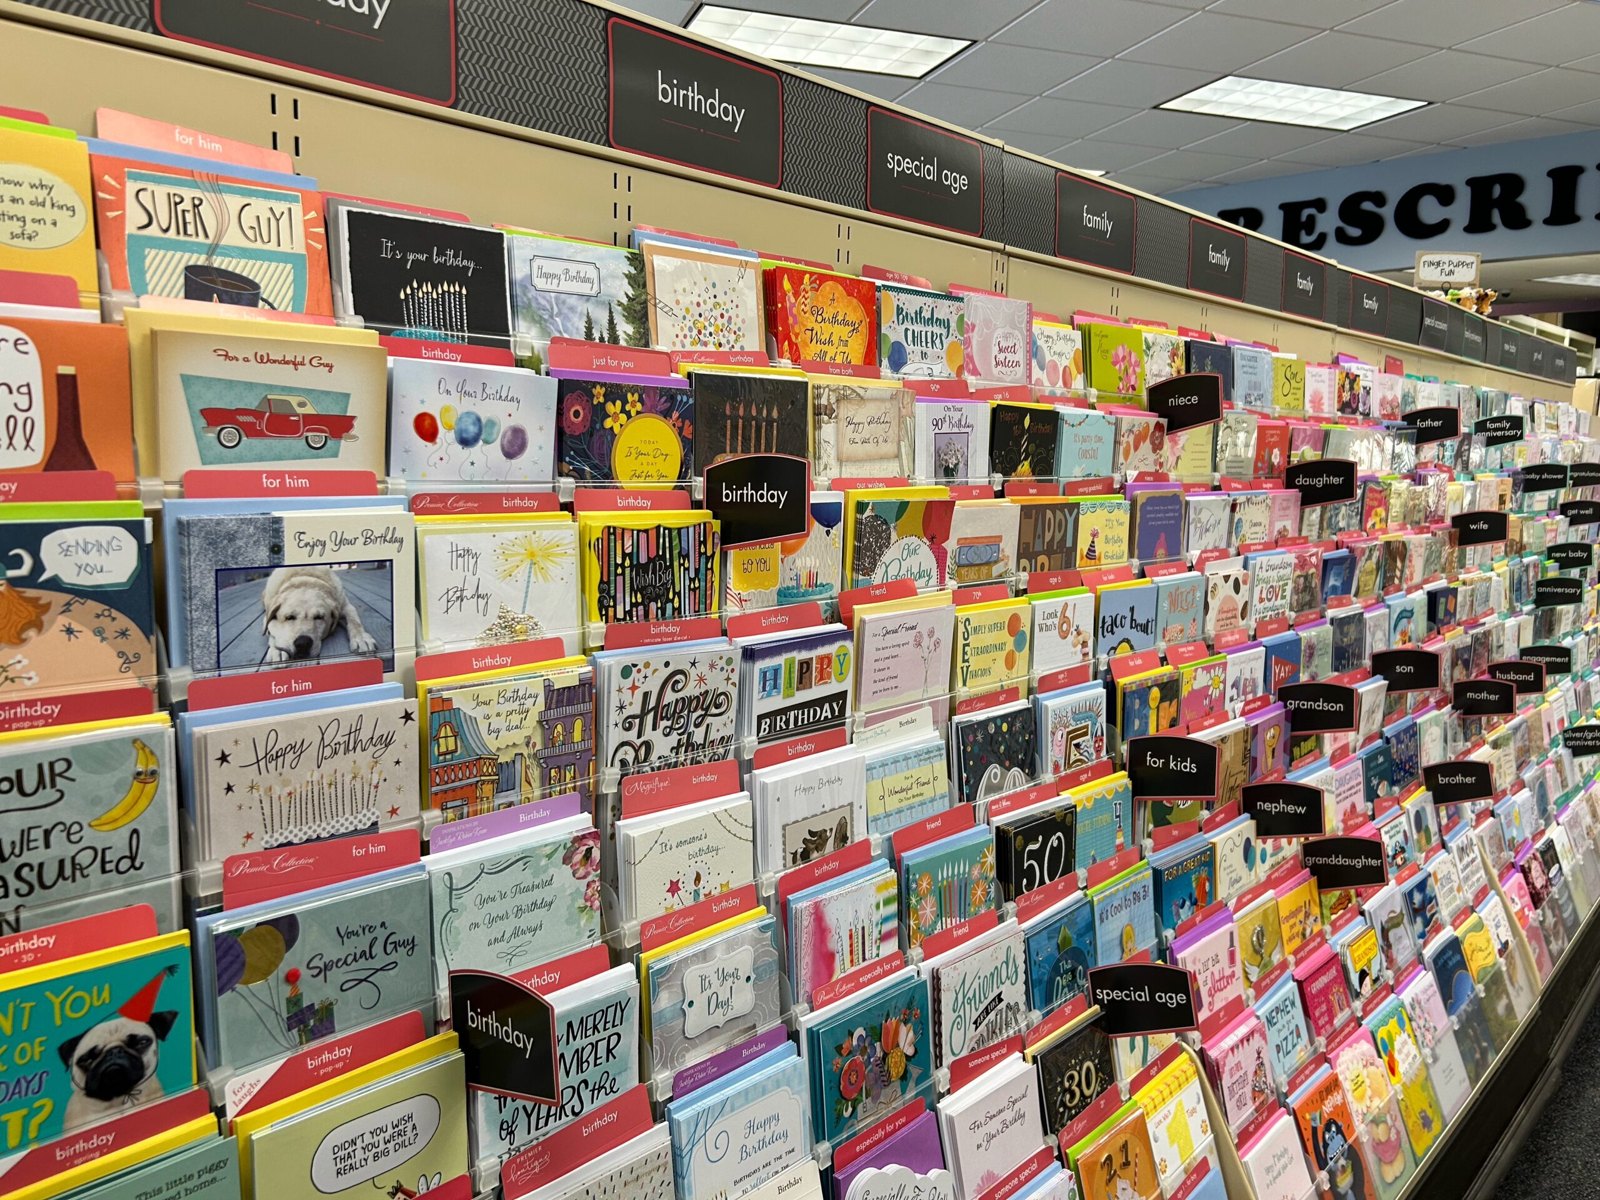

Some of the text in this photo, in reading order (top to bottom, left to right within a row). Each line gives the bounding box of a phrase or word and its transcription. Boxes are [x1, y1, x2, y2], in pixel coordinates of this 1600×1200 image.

[658, 70, 745, 133] birthday
[174, 126, 223, 153] for him
[886, 151, 969, 194] special age
[28, 177, 55, 197] why
[8, 195, 76, 219] an old king
[1217, 162, 1600, 251] ESCRI
[30, 217, 47, 226] on
[135, 187, 296, 250] SUPER GUY!
[1083, 204, 1114, 239] family
[9, 229, 39, 242] sofa?
[379, 238, 430, 269] It's your
[1208, 244, 1231, 272] family
[535, 264, 595, 292] Happy Birthday
[1296, 271, 1314, 297] family
[827, 292, 837, 307] A
[1363, 292, 1379, 315] family
[810, 305, 864, 339] Birthday
[895, 303, 951, 340] Birthday
[804, 325, 849, 350] Wish from
[903, 327, 945, 351] CHEERS
[996, 341, 1019, 356] Sweet
[212, 347, 335, 374] For a Wonderful Guy
[421, 346, 463, 364] birthday
[591, 355, 635, 370] just for you
[812, 349, 841, 365] All of
[919, 350, 929, 361] to
[993, 354, 1022, 370] Sixteen
[479, 381, 522, 412] Birthday
[1168, 393, 1199, 408] niece
[931, 416, 947, 432] 90th
[1416, 418, 1443, 429] father
[1475, 428, 1522, 438] anniversary
[1486, 420, 1511, 430] family
[262, 473, 310, 489] for him
[1294, 474, 1345, 489] daughter
[1541, 472, 1564, 480] shower
[502, 494, 539, 509] birthday
[616, 495, 652, 510] birthday
[721, 482, 788, 510] birthday
[1567, 507, 1593, 516] get well
[1020, 508, 1078, 554] HAPPY
[1469, 520, 1489, 530] wife
[57, 535, 123, 558] SENDING
[293, 526, 405, 558] Enjoy Your Birthday
[447, 540, 482, 577] Happy
[1551, 549, 1588, 559] new baby
[438, 575, 493, 617] Birthday
[869, 585, 888, 597] friend
[1536, 585, 1581, 596] anniversary
[761, 613, 790, 628] birthday
[1042, 610, 1059, 621] Look
[1099, 612, 1127, 639] taco
[650, 623, 681, 636] birthday
[1037, 622, 1057, 634] Who's
[472, 654, 513, 670] birthday
[1395, 664, 1414, 674] son
[1521, 653, 1569, 664] engagement
[760, 652, 850, 694] HAPPY
[1495, 671, 1535, 682] husband
[270, 679, 313, 695] for him
[471, 686, 541, 711] Your Birthday
[1466, 690, 1500, 702] mother
[482, 710, 491, 721] is
[621, 668, 733, 740] Happy
[1286, 697, 1344, 712] grandson
[758, 700, 844, 738] BIRTHDAY
[486, 722, 503, 741] big
[239, 713, 398, 776] Happy Birthday
[786, 741, 816, 757] birthday
[1146, 751, 1197, 774] for kids
[691, 772, 719, 785] birthday
[793, 775, 844, 799] Happy Birthday
[1438, 773, 1477, 785] brother
[518, 807, 552, 824] Birthday
[1256, 799, 1307, 816] nephew
[925, 818, 942, 831] friend
[352, 843, 387, 858] for him
[1305, 853, 1382, 870] granddaughter
[813, 859, 840, 877] birthday
[1021, 831, 1067, 895] 50
[509, 873, 556, 899] Treasured
[468, 894, 557, 932] on Birthday
[711, 896, 741, 914] birthday
[335, 920, 389, 947] You're a
[487, 920, 545, 948] and Always
[952, 924, 970, 938] friend
[306, 931, 419, 984] Special Guy
[698, 967, 741, 995] It's Your
[859, 958, 901, 983] especially for you
[45, 982, 112, 1028] YOU
[706, 985, 735, 1016] Day!
[1095, 985, 1187, 1008] special age
[467, 1000, 534, 1060] birthday
[565, 996, 632, 1048] MERELY
[13, 1036, 48, 1066] OF
[306, 1043, 354, 1071] birthday
[741, 1040, 767, 1058] Birthday
[967, 1045, 1008, 1069] someone special
[1063, 1059, 1097, 1108] 30
[332, 1111, 415, 1157] DIDN'T YOU WISH
[581, 1110, 619, 1138] birthday
[743, 1110, 781, 1141] Happy
[855, 1115, 907, 1153] especially for you
[55, 1130, 117, 1162] birthday
[332, 1126, 410, 1169] THAT WERE
[737, 1126, 790, 1165] Birthday
[335, 1148, 391, 1180] REALLY BIG
